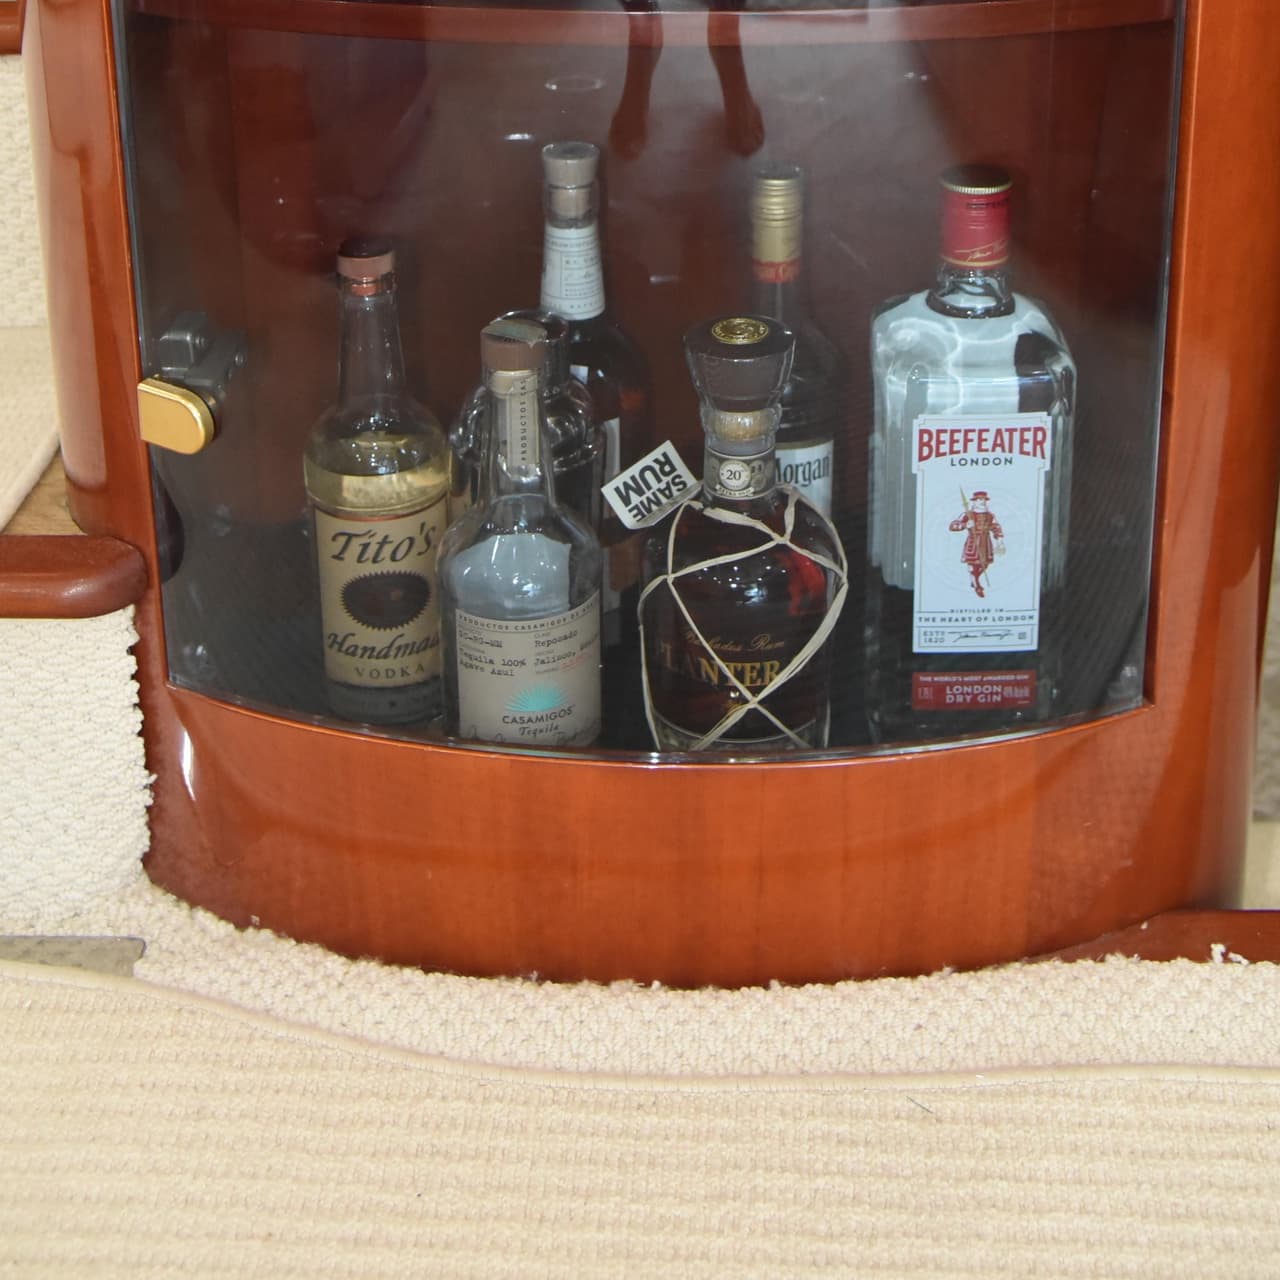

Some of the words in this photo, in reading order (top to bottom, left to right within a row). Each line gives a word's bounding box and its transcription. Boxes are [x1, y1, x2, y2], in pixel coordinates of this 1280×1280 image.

[918, 426, 1048, 463] BEEFEATER
[950, 457, 1013, 467] LONDON
[614, 451, 678, 508] RUM
[726, 469, 741, 480] 20
[628, 474, 688, 522] SAME
[331, 521, 436, 564] Tito's
[459, 614, 509, 631] PRODUCTOS
[514, 617, 567, 631] CASAMIGOS
[501, 658, 526, 667] 100%
[354, 663, 425, 680] VODKA
[946, 685, 1002, 694] LONDON
[946, 694, 973, 704] DRY
[977, 694, 1002, 703] GIN
[502, 705, 574, 725] CASAMIGOS
[519, 723, 559, 738] Tequila
